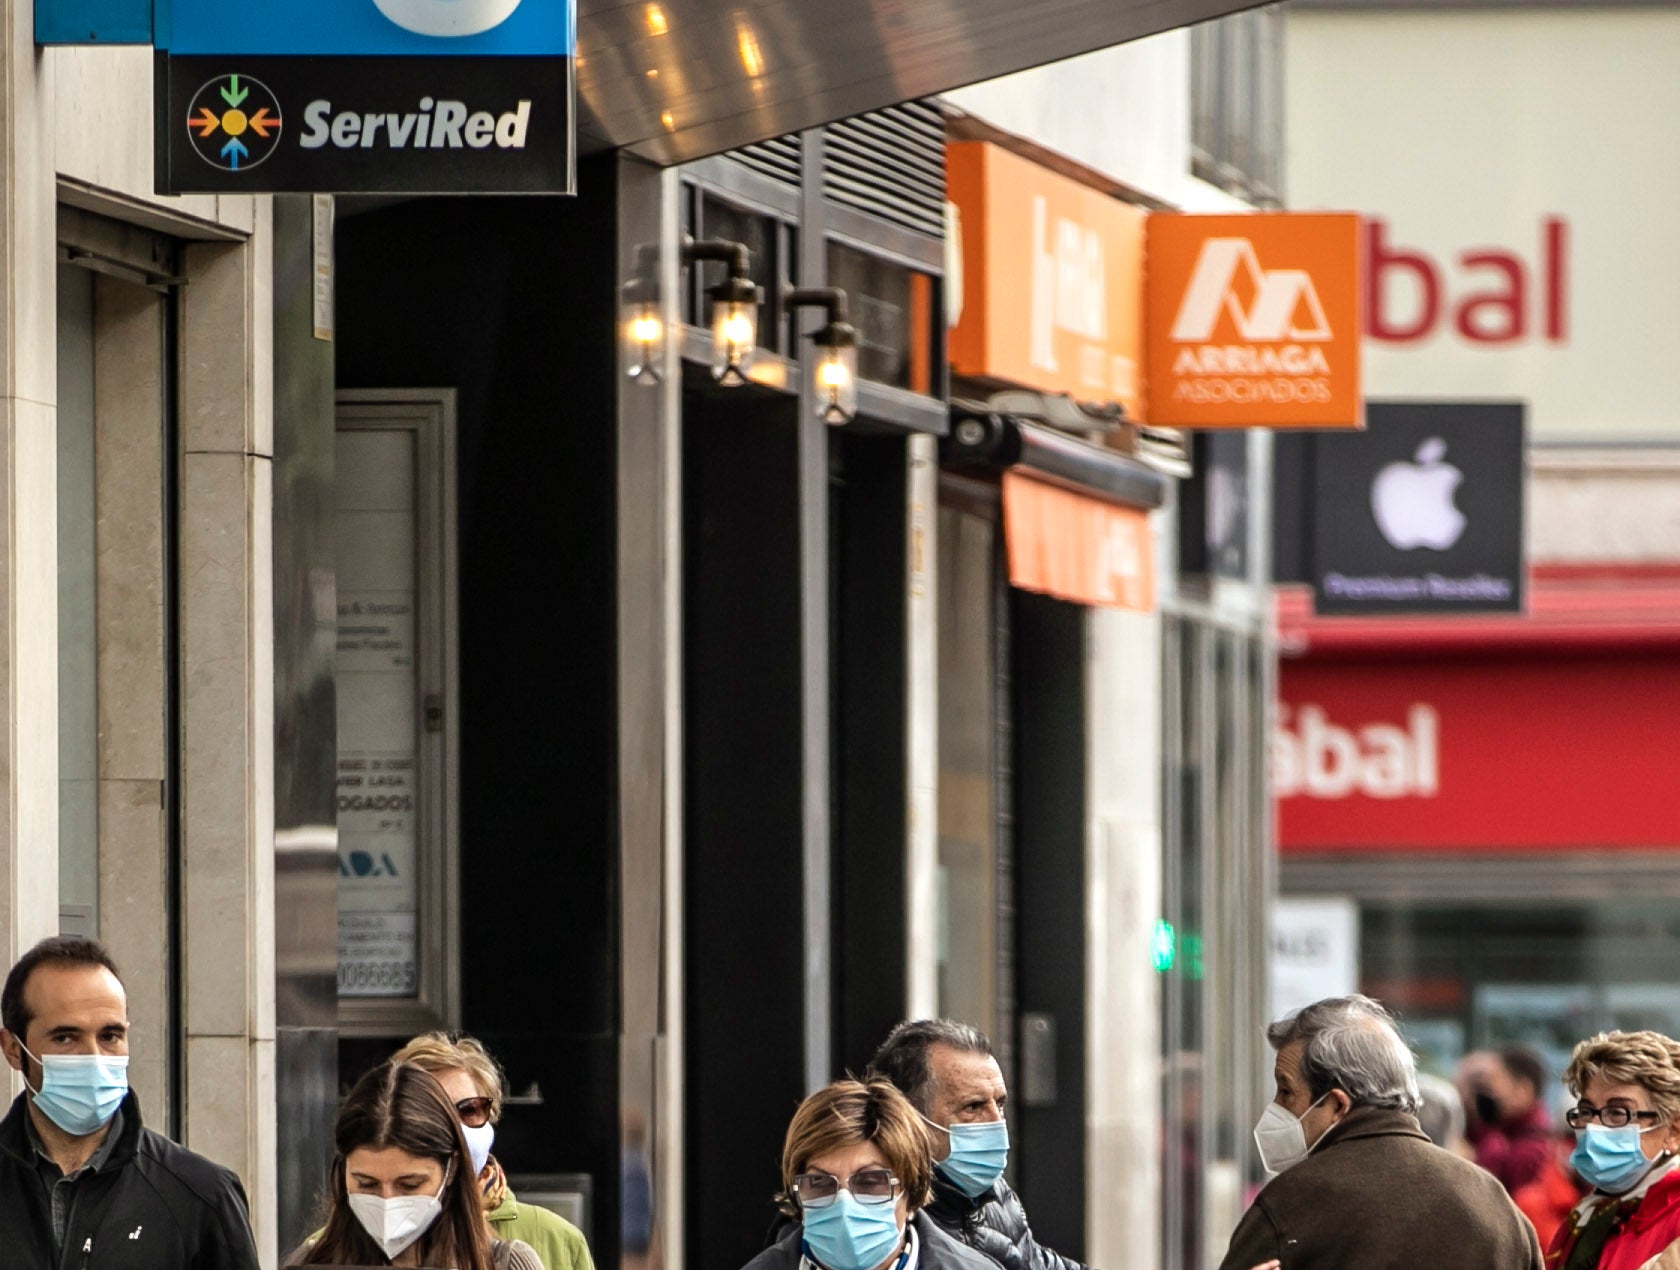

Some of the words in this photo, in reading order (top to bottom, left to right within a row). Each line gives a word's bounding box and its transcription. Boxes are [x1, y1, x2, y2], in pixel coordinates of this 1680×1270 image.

[299, 97, 532, 149] ServiRed
[1172, 344, 1330, 374] ARRIAGA
[1172, 378, 1332, 403] ASOCIADOS
